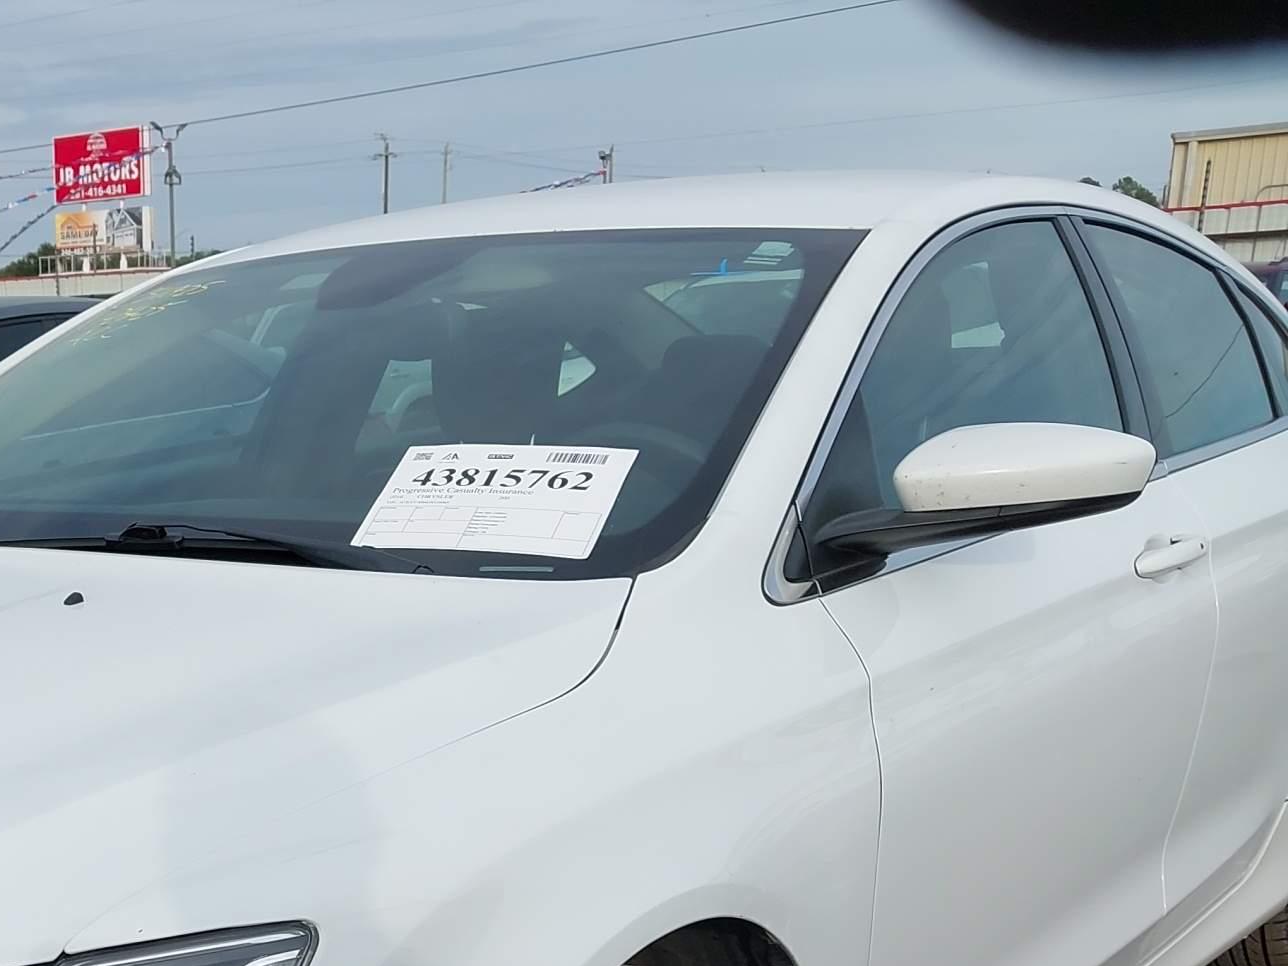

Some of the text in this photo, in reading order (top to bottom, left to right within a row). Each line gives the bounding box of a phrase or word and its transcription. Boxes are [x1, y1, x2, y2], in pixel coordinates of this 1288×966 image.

[58, 158, 139, 186] JB MOTORS
[412, 468, 594, 491] 43815762
[392, 487, 534, 496] Progressive Casualty Insurance
